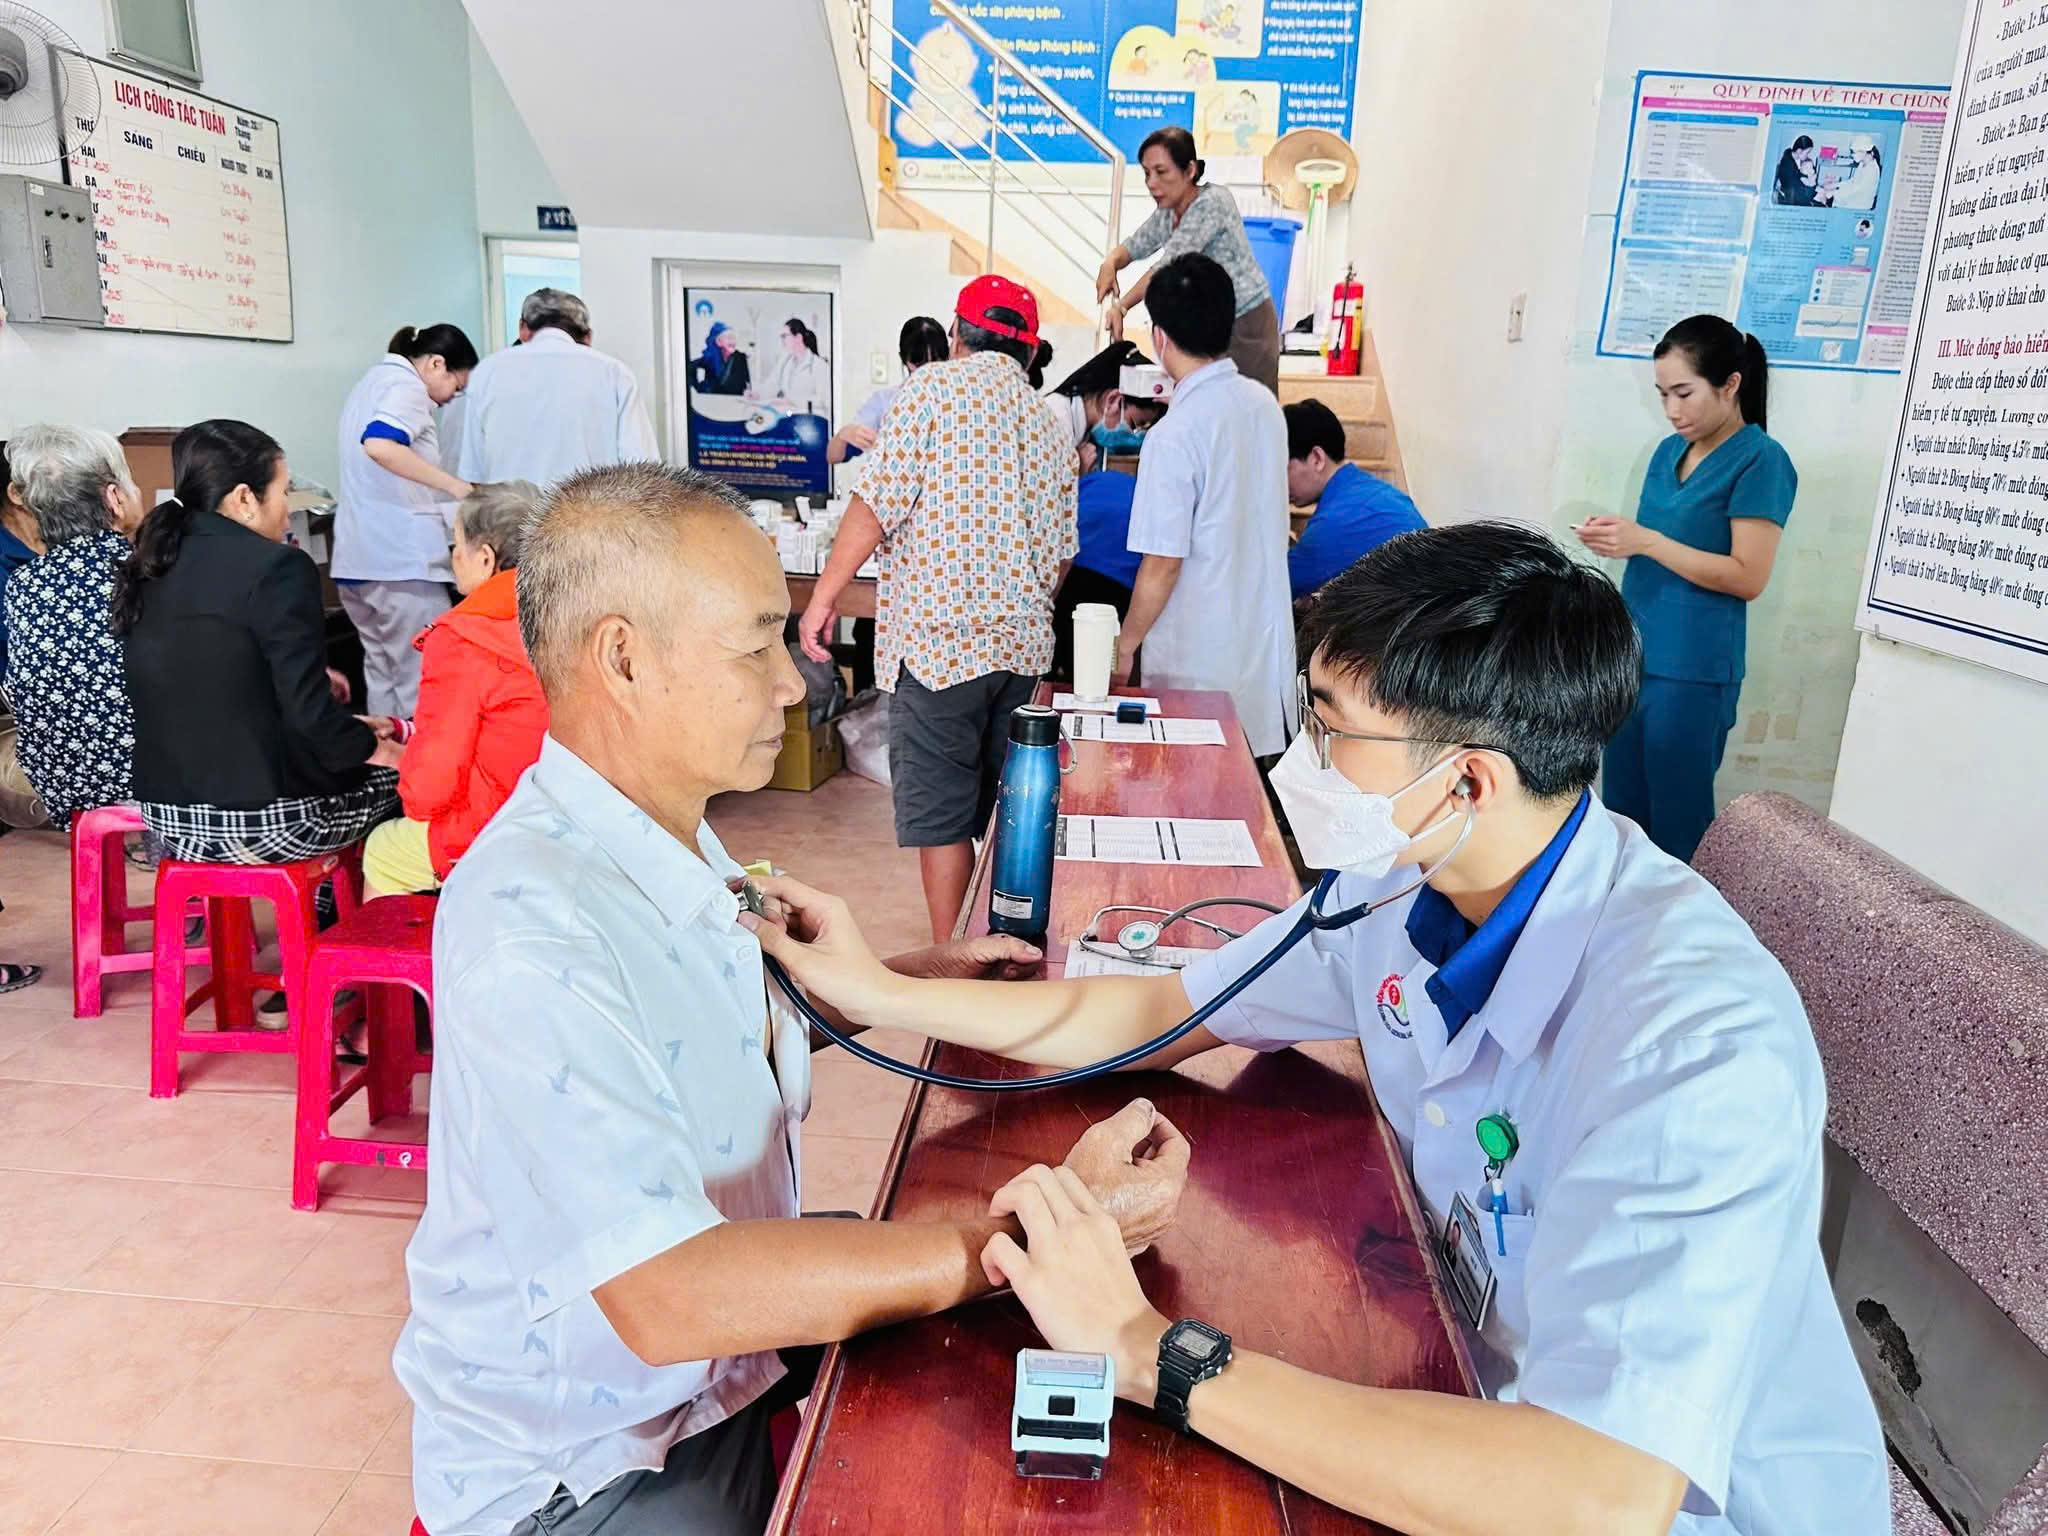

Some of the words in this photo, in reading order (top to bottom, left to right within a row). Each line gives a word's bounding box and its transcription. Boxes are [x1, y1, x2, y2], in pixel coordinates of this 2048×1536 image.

[2001, 15, 2025, 41] Bước
[1994, 48, 2024, 78] người
[2027, 71, 2042, 98] số
[114, 79, 142, 110] LỊCH
[144, 88, 176, 120] CÔNG
[176, 98, 197, 127] TÁC
[198, 104, 226, 136] TUẦN
[123, 129, 153, 150] SÁNG
[1982, 122, 2006, 145] Bước
[2017, 114, 2039, 137] Bạn
[81, 145, 96, 159] HAI
[1954, 160, 1976, 185] hiểm
[1975, 165, 1984, 184] y
[1985, 153, 1998, 177] tế
[1996, 155, 2009, 177] tự
[2008, 145, 2045, 174] nguyện
[85, 175, 97, 188] BA
[1948, 197, 1978, 217] hướng
[1978, 186, 1998, 211] dẫn
[1999, 183, 2018, 206] của
[2020, 178, 2039, 205] đại
[1942, 231, 1976, 255] phương
[1976, 224, 1998, 244] thức
[2027, 212, 2047, 235] nơi
[1967, 258, 1977, 283] lý
[1978, 256, 1994, 276] thu
[1995, 254, 2019, 276] hoặc
[2020, 252, 2034, 270] cơ
[2034, 253, 2048, 273] qu
[1945, 292, 1967, 313] Bước
[1975, 289, 1994, 313] Nộp
[1995, 287, 2006, 307] tờ
[2006, 284, 2029, 306] khai
[2028, 283, 2046, 304] cho
[1953, 338, 1974, 357] Mức
[1976, 336, 2001, 360] đóng
[2003, 334, 2023, 355] bảo
[1932, 371, 1954, 394] Được
[1954, 370, 1974, 389] chia
[1975, 368, 1992, 393] cấp
[1993, 369, 2015, 389] theo
[2016, 365, 2032, 389] số
[1911, 400, 1932, 421] hiểm
[1932, 408, 1940, 425] y
[1940, 400, 1952, 422] tế
[1951, 406, 1963, 426] tự
[2000, 408, 2034, 428] Lương
[1911, 434, 1934, 457] Người
[1933, 434, 1947, 454] thứ
[1967, 436, 1989, 461] Đóng
[1990, 434, 2011, 462] bằng
[1906, 465, 1928, 487] Người
[1927, 466, 1942, 485] thứ
[1948, 468, 1970, 493] Đóng
[1970, 466, 1991, 495] bằng
[2008, 473, 2028, 494] mức
[1900, 495, 1921, 518] Người
[1921, 497, 1935, 517] thứ
[1942, 500, 1964, 525] Đóng
[1963, 499, 1985, 528] bằng
[2001, 509, 2020, 529] mức
[2021, 509, 2045, 537] đóng
[1894, 525, 1916, 548] Người
[1915, 527, 1930, 548] thứ
[1936, 532, 1957, 556] Đóng
[1957, 532, 1978, 560] bằng
[1994, 543, 2015, 563] mức
[2014, 543, 2038, 572] đóng
[1888, 555, 1909, 577] Người
[1908, 558, 1920, 578] thứ
[1949, 566, 1970, 592] Đóng
[1969, 568, 1989, 597] bằng
[2004, 579, 2024, 600] mức
[2023, 581, 2045, 609] đóng
